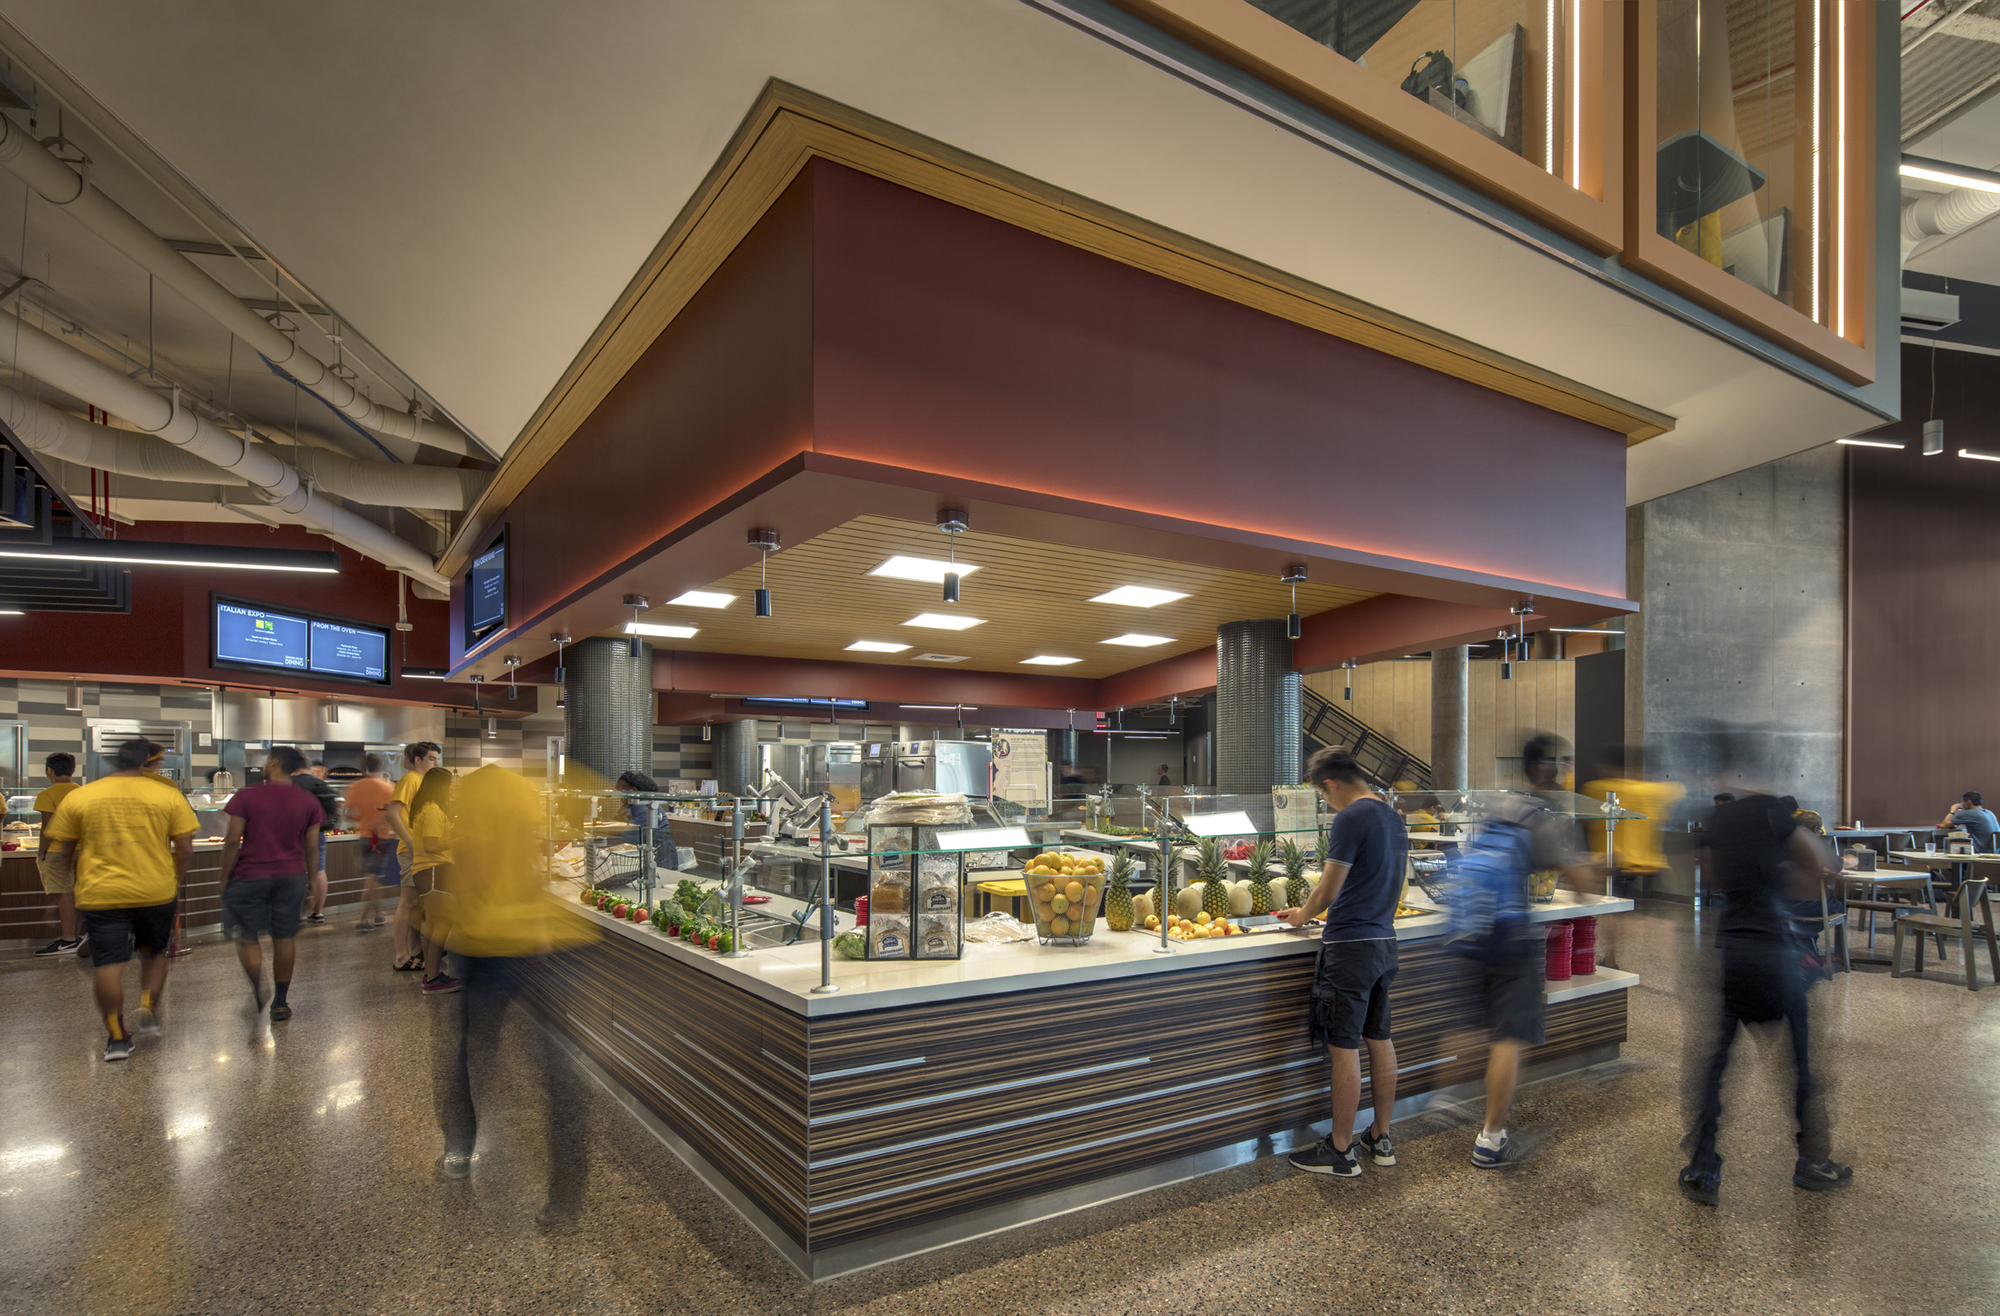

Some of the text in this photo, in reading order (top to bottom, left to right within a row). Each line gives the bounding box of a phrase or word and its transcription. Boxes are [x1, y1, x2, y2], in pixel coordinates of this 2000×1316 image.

[220, 605, 265, 618] ITALIAN EXPO
[313, 621, 356, 634] FROM THE OVEN
[285, 658, 303, 666] DINING
